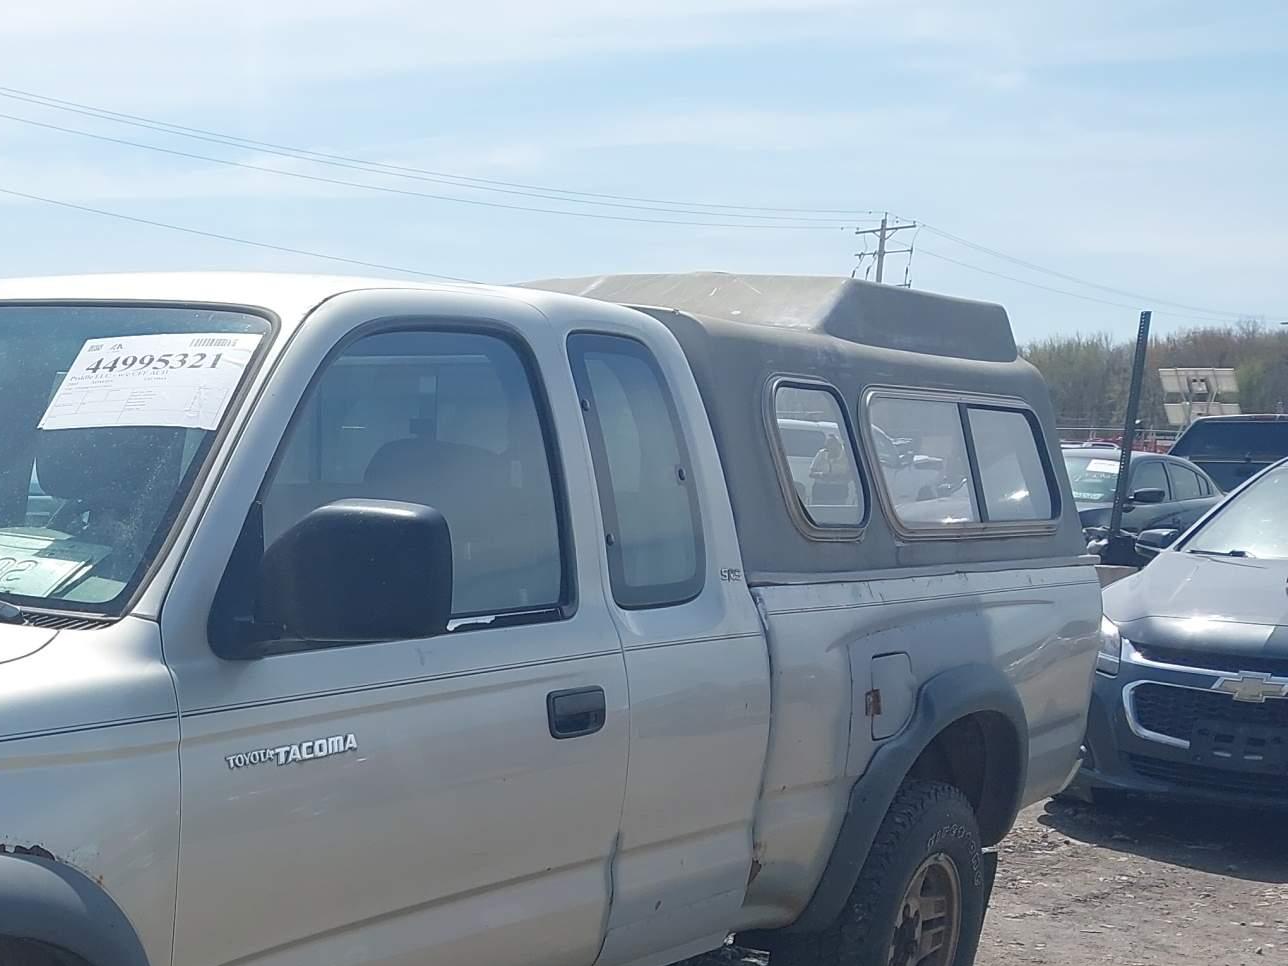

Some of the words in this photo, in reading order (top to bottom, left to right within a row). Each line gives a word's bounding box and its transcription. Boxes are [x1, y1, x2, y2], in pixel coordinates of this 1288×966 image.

[85, 352, 223, 374] 44995321
[225, 748, 275, 769] TOYOTA
[274, 733, 358, 765] TACOMA
